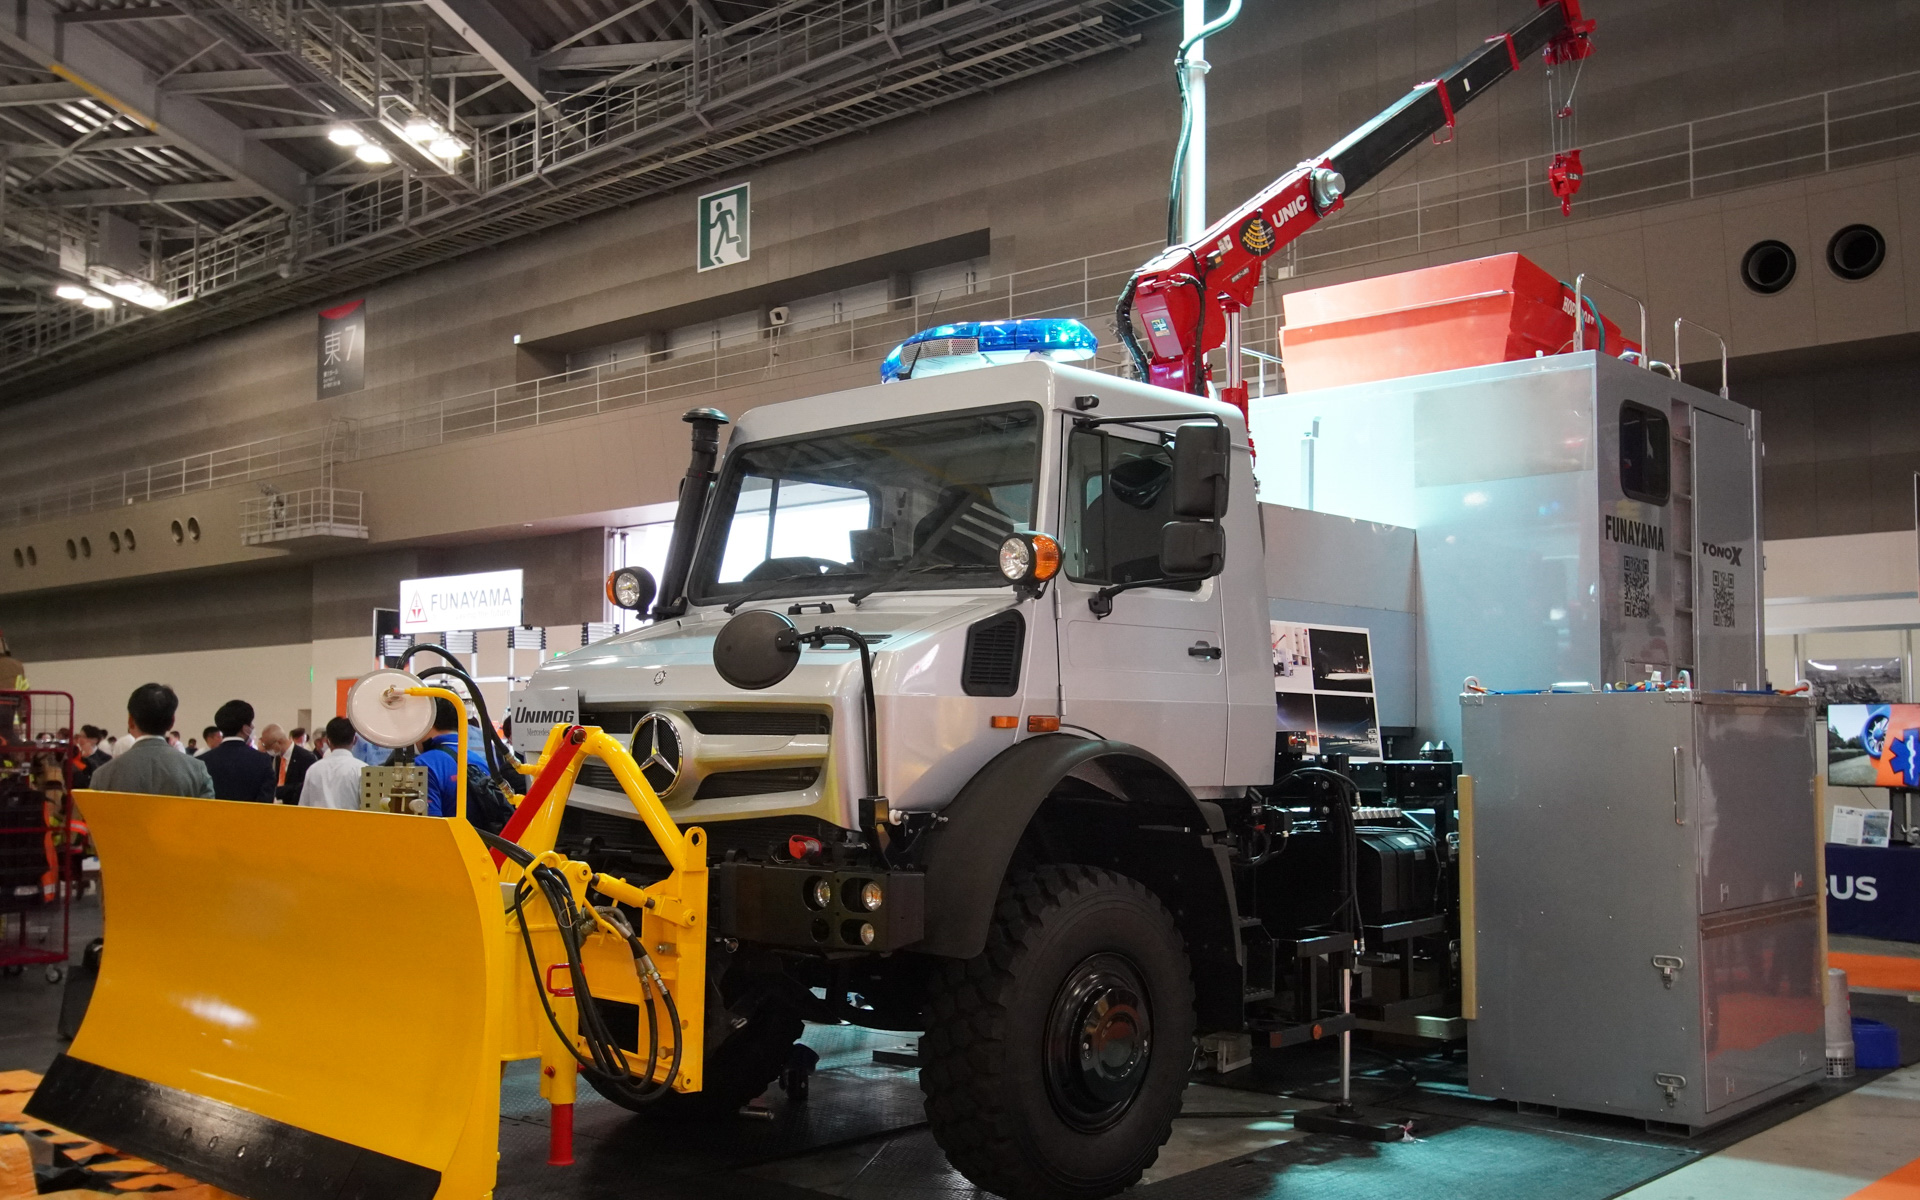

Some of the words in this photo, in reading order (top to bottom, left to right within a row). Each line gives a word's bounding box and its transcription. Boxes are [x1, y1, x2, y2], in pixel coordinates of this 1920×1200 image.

[1272, 194, 1308, 228] UNIC
[1605, 514, 1665, 552] FUNAYAMA
[1702, 542, 1743, 567] TONOX
[431, 587, 512, 611] FUNAYAMA
[514, 706, 575, 724] UNIMOG
